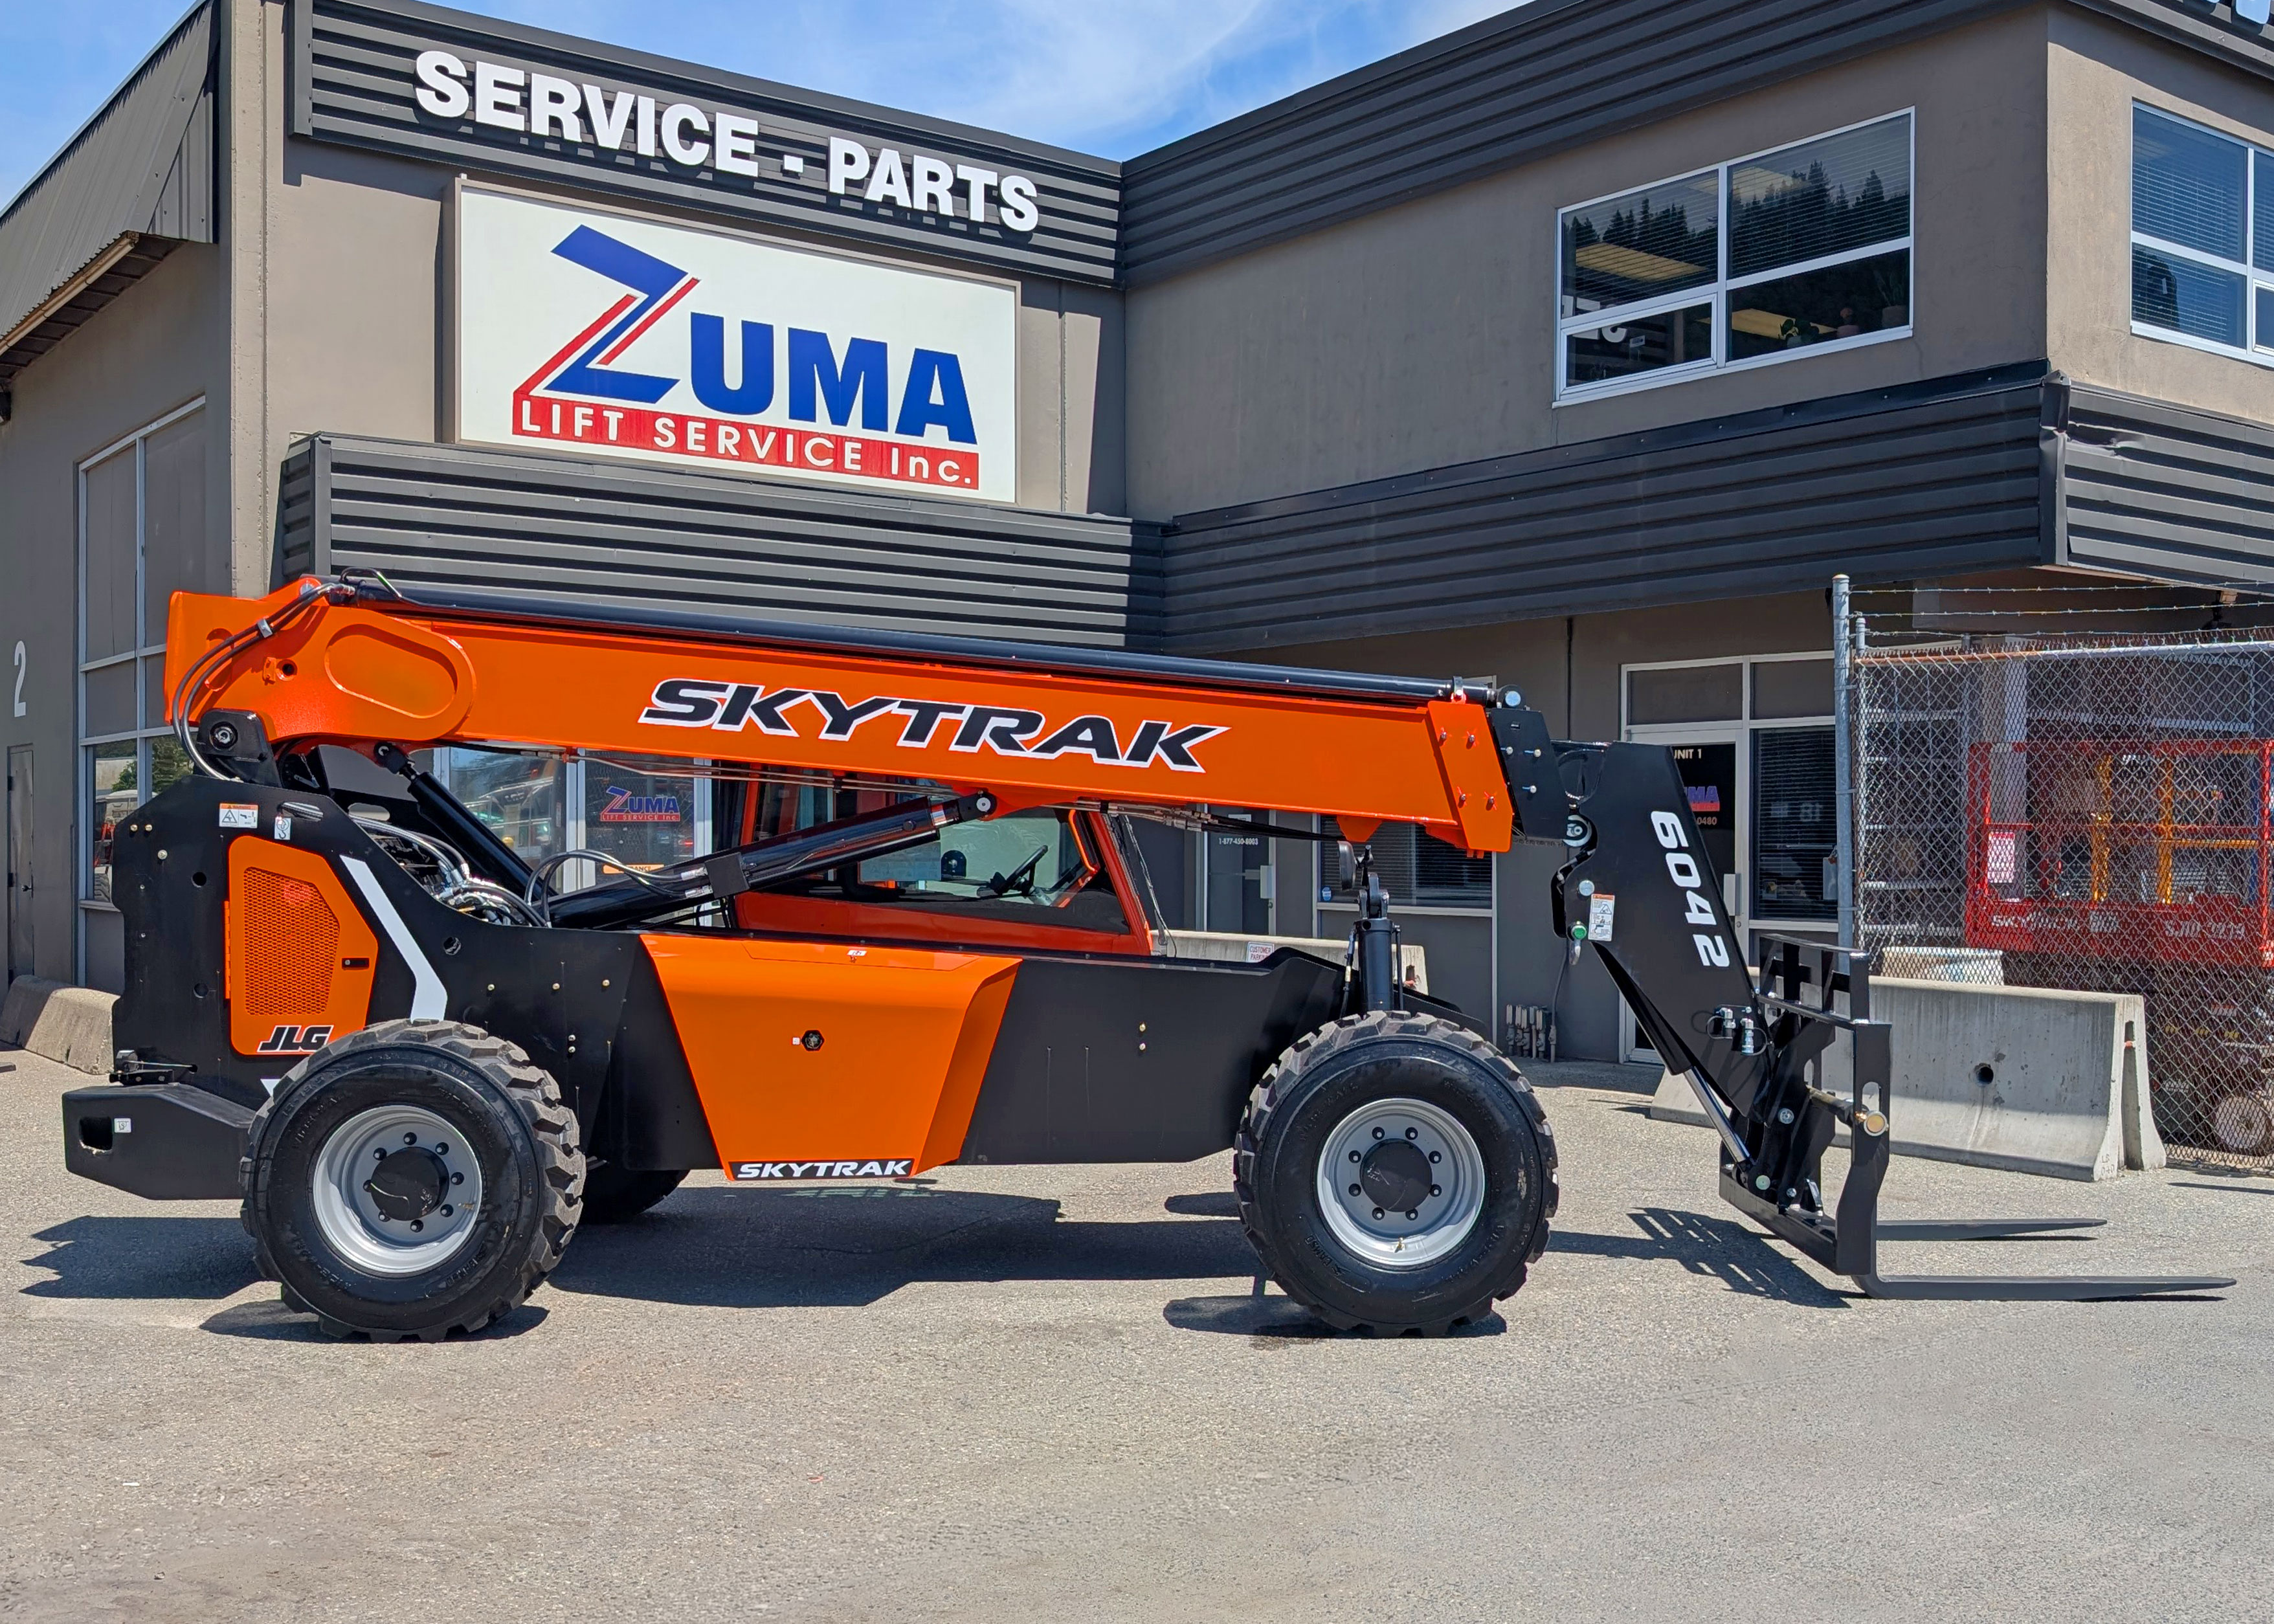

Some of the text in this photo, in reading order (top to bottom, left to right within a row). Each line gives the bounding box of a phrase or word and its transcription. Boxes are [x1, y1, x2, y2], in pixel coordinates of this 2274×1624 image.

[415, 50, 759, 178] SERVICE
[829, 136, 1039, 232] PARTS
[513, 224, 978, 445] ZUMA
[522, 400, 972, 484] LIFT SERVICE Inc.
[14, 641, 26, 717] 2
[638, 678, 1231, 773] SKYTRAK
[1697, 748, 1702, 759] 1
[601, 786, 680, 813] ZUMA
[1684, 786, 1720, 803] MA
[1695, 816, 1717, 825] 0480
[1651, 810, 1730, 968] 6042
[257, 1025, 334, 1052] JLG
[737, 1161, 911, 1178] SKYTRAK
